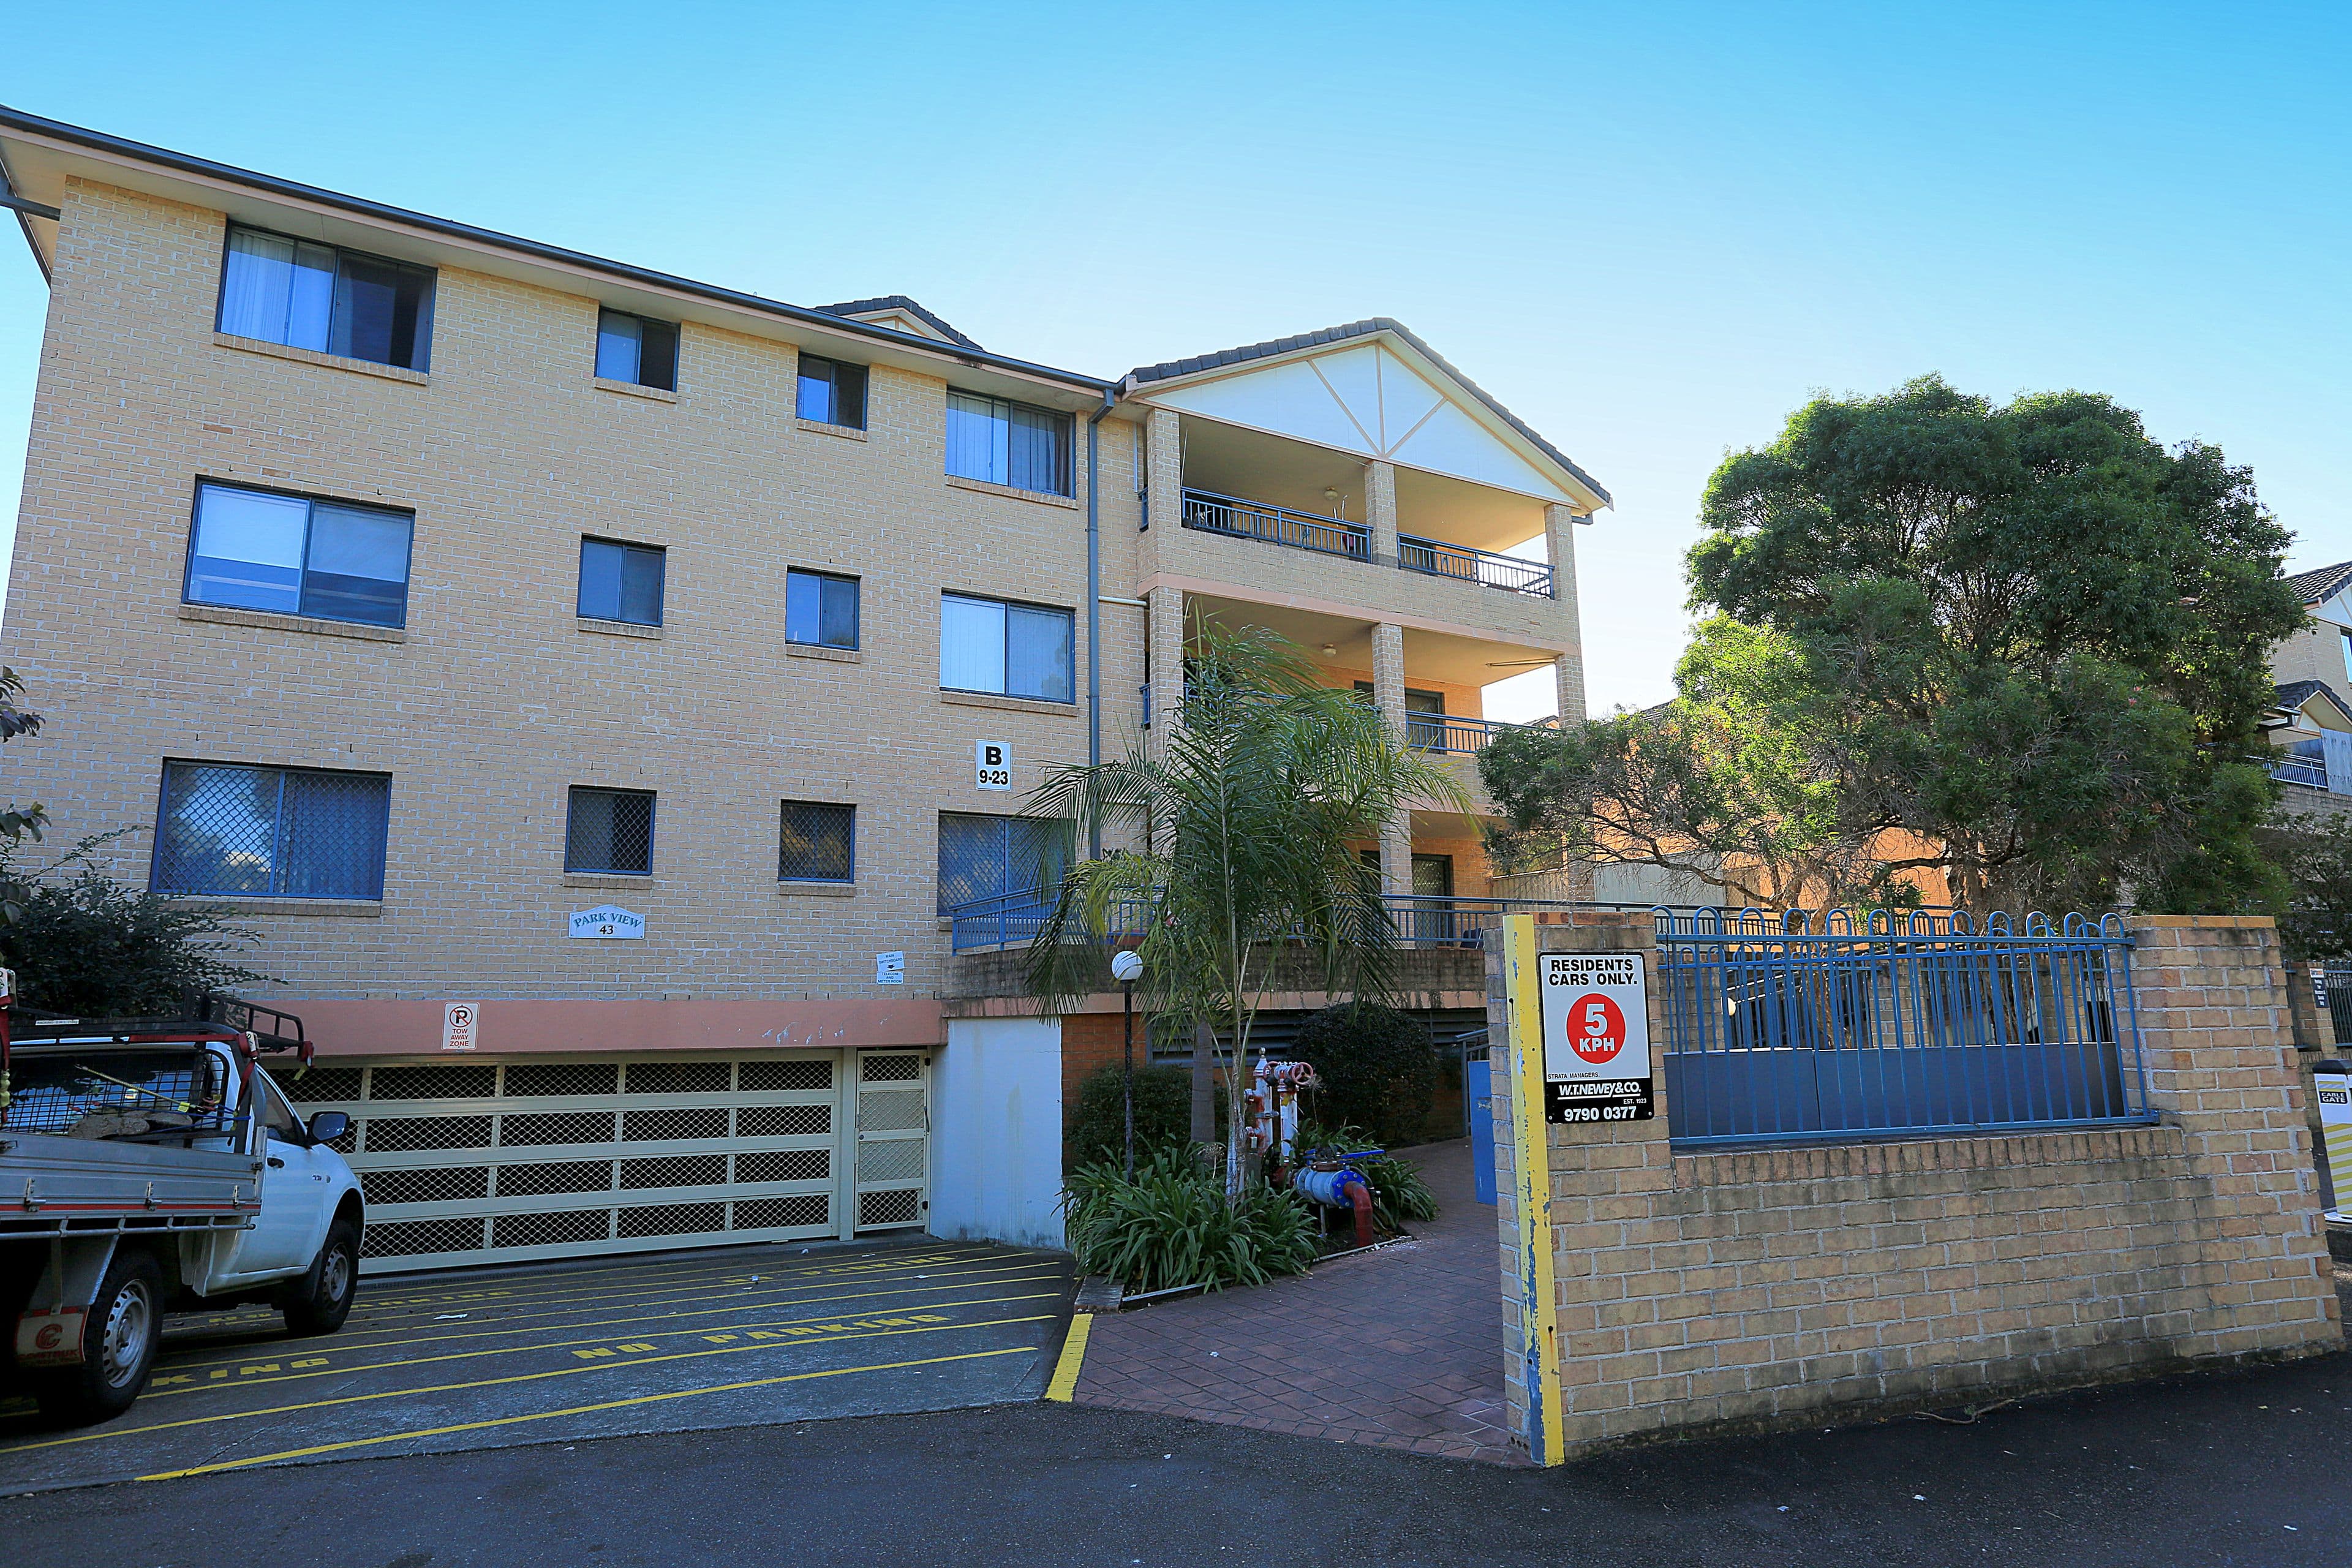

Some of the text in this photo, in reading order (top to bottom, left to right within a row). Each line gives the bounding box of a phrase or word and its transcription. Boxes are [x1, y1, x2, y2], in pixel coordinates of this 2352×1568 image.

[986, 745, 1002, 766] B
[979, 769, 1008, 785] 9-23
[573, 913, 642, 928] PARK VIEW
[600, 925, 614, 935] 43
[1551, 959, 1634, 972] RESIDENTS
[1548, 973, 1638, 986] CARS ONLY.
[1584, 1003, 1608, 1036] 5
[1579, 1038, 1615, 1052] KPH
[1564, 1106, 1637, 1121] 9790 0377
[571, 1313, 951, 1360] NO PARKING
[151, 1357, 330, 1387] KING
